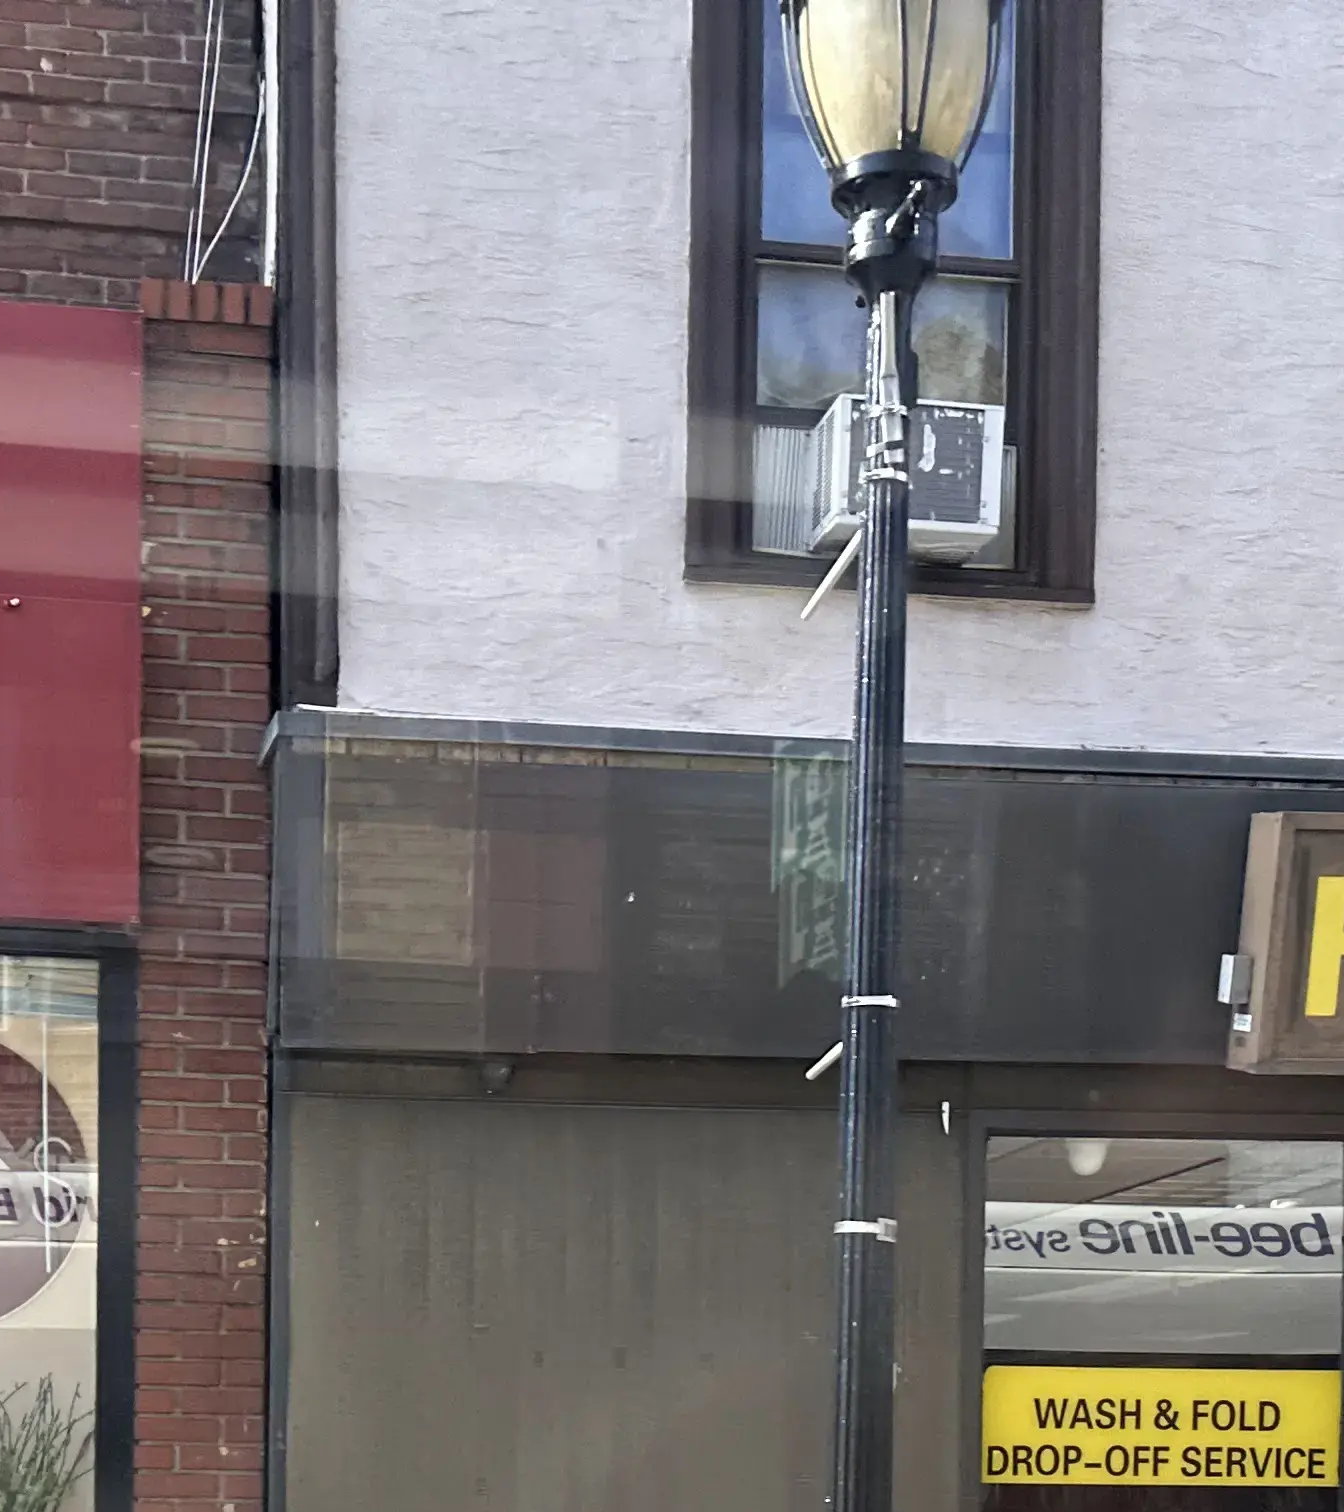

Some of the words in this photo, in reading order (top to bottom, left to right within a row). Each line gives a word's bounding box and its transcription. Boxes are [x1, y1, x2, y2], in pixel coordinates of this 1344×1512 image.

[1034, 1398, 1143, 1432] WASH
[1153, 1399, 1180, 1432] &
[1191, 1400, 1282, 1432] FOLD
[986, 1445, 1171, 1478] DROP-OFF
[1181, 1446, 1326, 1480] SERVICE
